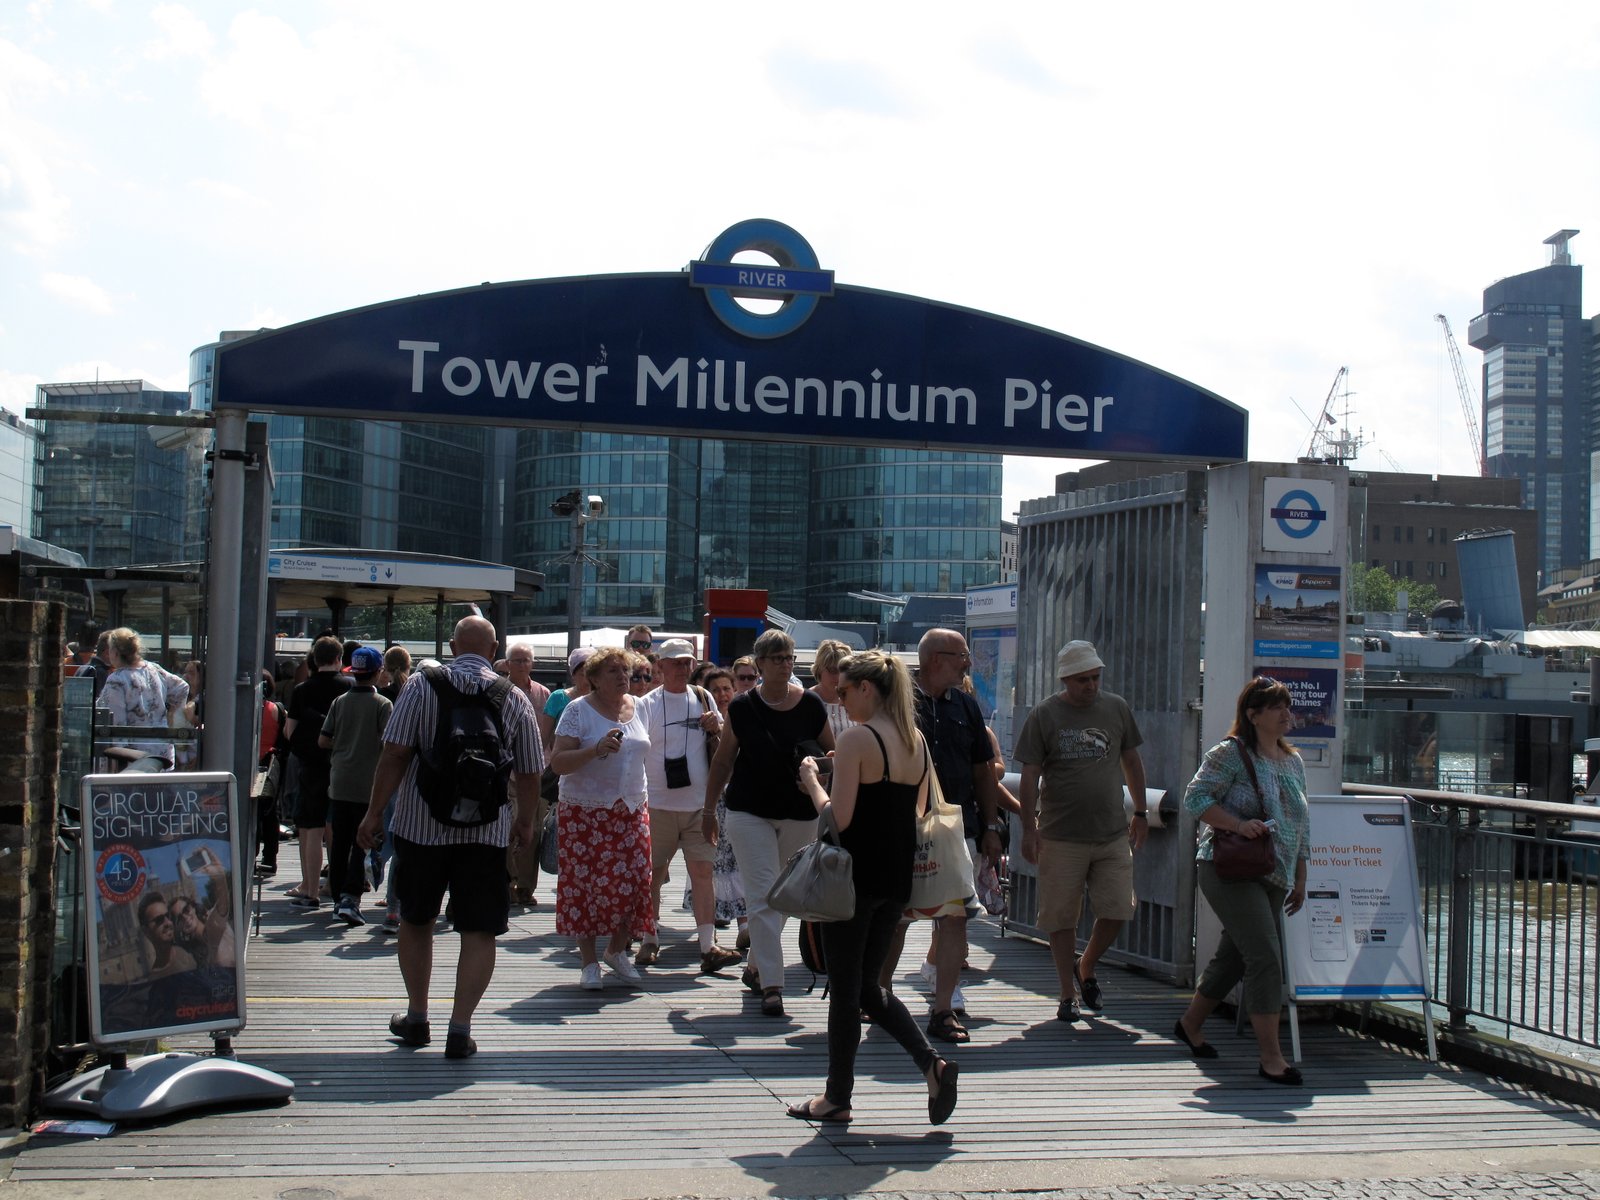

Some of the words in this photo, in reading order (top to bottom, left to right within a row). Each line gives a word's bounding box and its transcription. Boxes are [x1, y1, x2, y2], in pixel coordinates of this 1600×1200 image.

[738, 270, 787, 288] RIVER
[398, 339, 609, 403] Tower
[636, 354, 977, 426] Millennium
[1003, 377, 1114, 433] Pier
[1289, 510, 1309, 519] RIVER
[283, 558, 296, 567] City
[296, 559, 317, 567] Cruises
[973, 597, 994, 607] Information
[1258, 641, 1312, 650] thamesclippers.com
[1308, 690, 1328, 699] tour
[1290, 698, 1322, 707] Thames
[92, 790, 201, 816] CIRCULAR
[93, 812, 228, 839] SIGHTSEEING
[1311, 846, 1328, 854] urn
[1329, 845, 1351, 854] Your
[1353, 845, 1382, 854] Phone
[1309, 857, 1328, 867] Into
[1330, 858, 1352, 867] Your
[1353, 858, 1382, 867] Ticket
[109, 860, 132, 881] 45
[176, 1001, 237, 1019] citycruises
